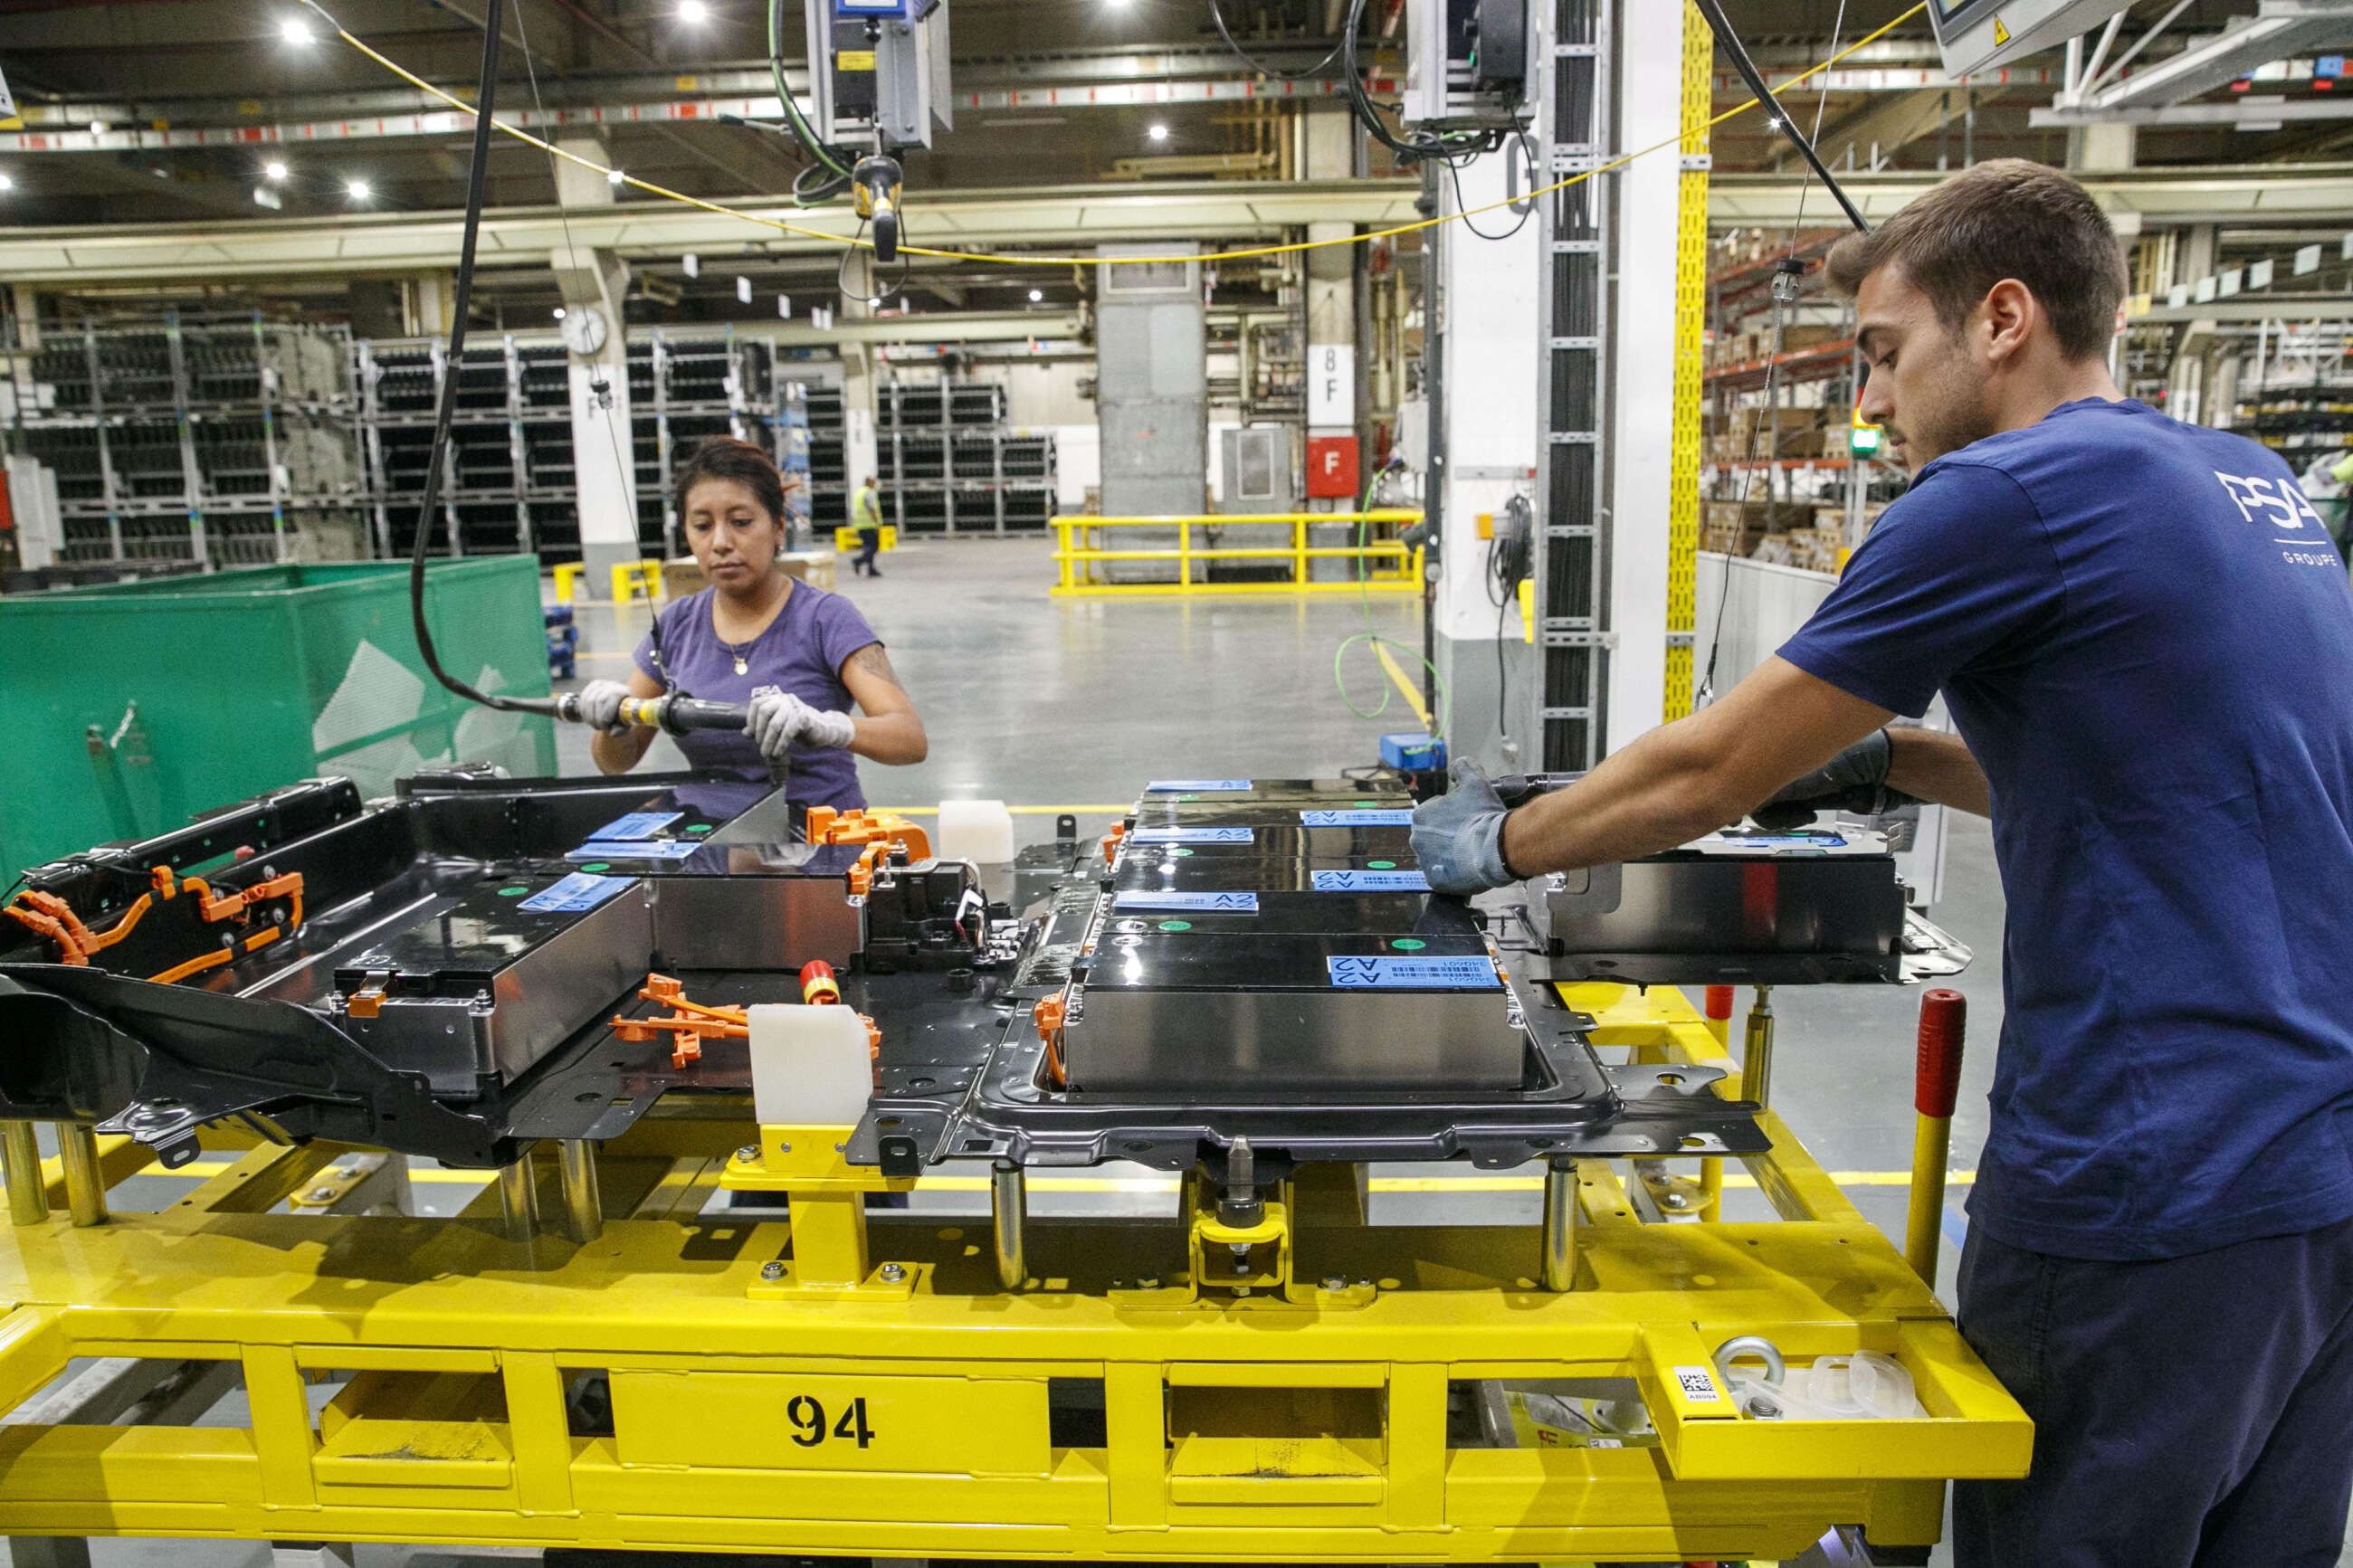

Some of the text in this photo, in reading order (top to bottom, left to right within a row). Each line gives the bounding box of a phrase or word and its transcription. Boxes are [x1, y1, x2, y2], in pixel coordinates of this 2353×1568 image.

[1326, 349, 1335, 372] 8
[1327, 380, 1337, 402] F
[1325, 452, 1339, 475] F
[2214, 471, 2326, 528] PSA
[2282, 551, 2338, 566] GROUPE
[1333, 957, 1377, 971] A2
[1336, 972, 1381, 984] A2
[786, 1394, 875, 1449] 94
